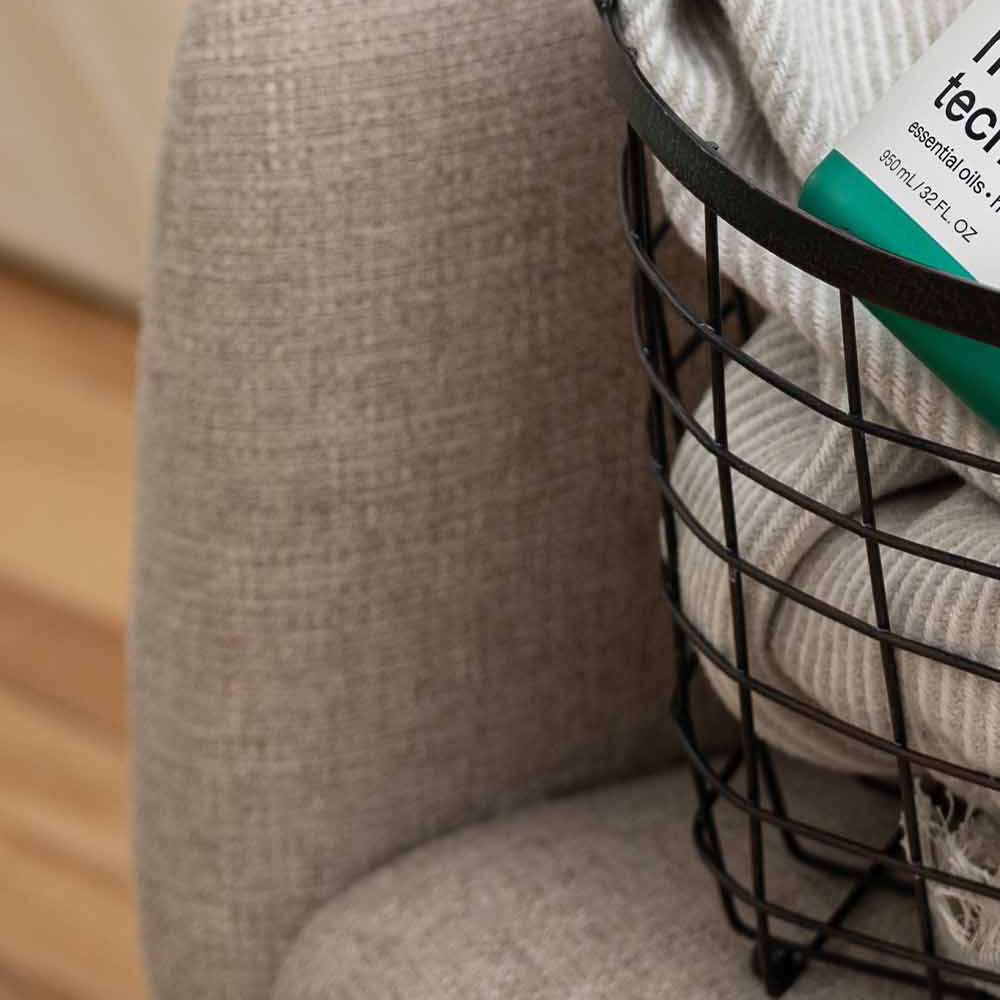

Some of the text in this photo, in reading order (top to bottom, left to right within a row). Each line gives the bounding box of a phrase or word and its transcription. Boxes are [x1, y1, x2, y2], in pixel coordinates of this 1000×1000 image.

[879, 149, 902, 172] 950
[896, 167, 916, 189] mL
[919, 185, 938, 207] 32
[933, 199, 951, 225] FL.
[953, 218, 978, 243] OZ
[908, 121, 964, 172] essential
[958, 167, 986, 195] oils
